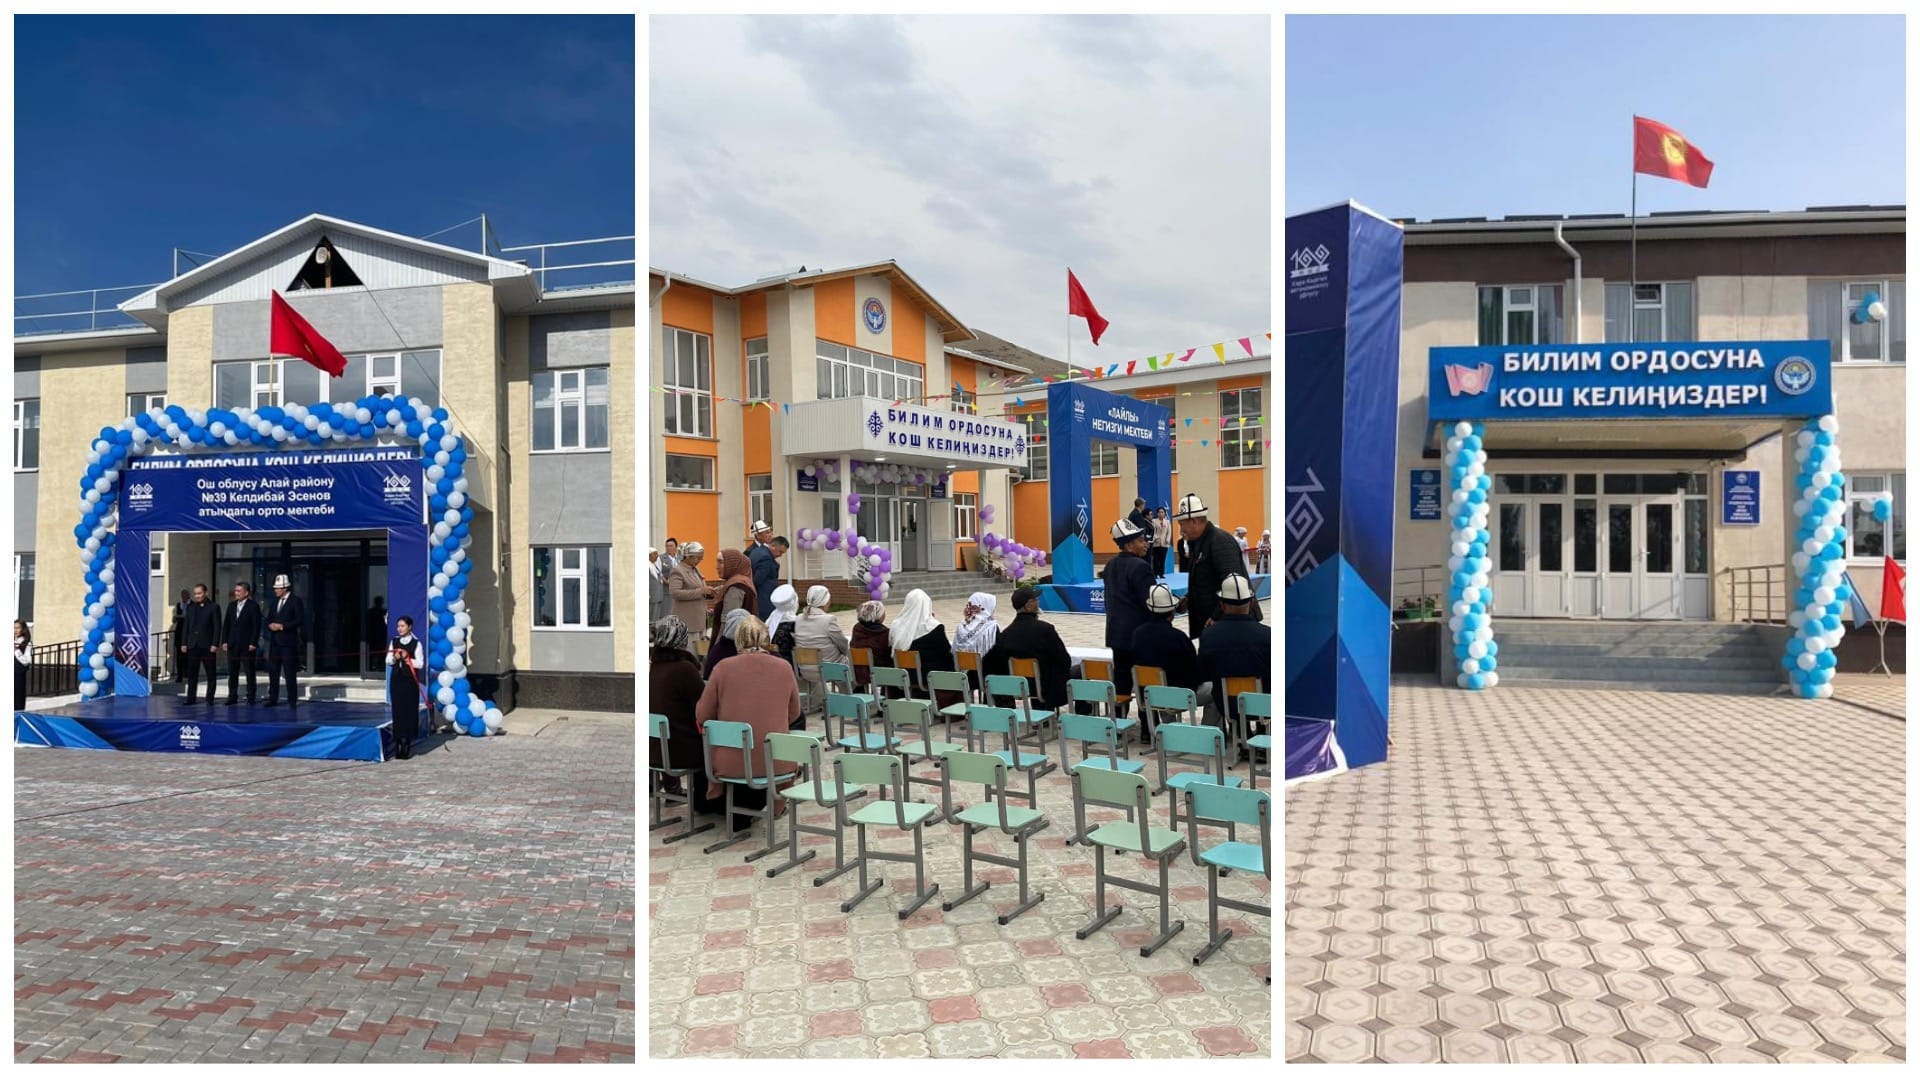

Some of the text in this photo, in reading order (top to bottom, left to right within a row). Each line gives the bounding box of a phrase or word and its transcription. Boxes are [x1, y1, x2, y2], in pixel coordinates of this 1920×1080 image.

[1503, 348, 1765, 374] БИЛИМ ОРДОСУНА
[1500, 384, 1767, 409] КОШ КЕЛИҢИЗДЕР!
[888, 409, 1013, 440] БИЛИМ ОРДОСУНА
[1092, 418, 1123, 435] НЕГИЗГИ
[1124, 426, 1153, 440] МЕКТЕБИ
[888, 431, 1015, 459] КОШ КЕЛИҢИЗДЕР!
[197, 476, 334, 491] Ош облусу Алай району
[201, 490, 331, 504] №39 Келдибай Эсенов
[198, 503, 335, 518] атындагы орто мектеби
